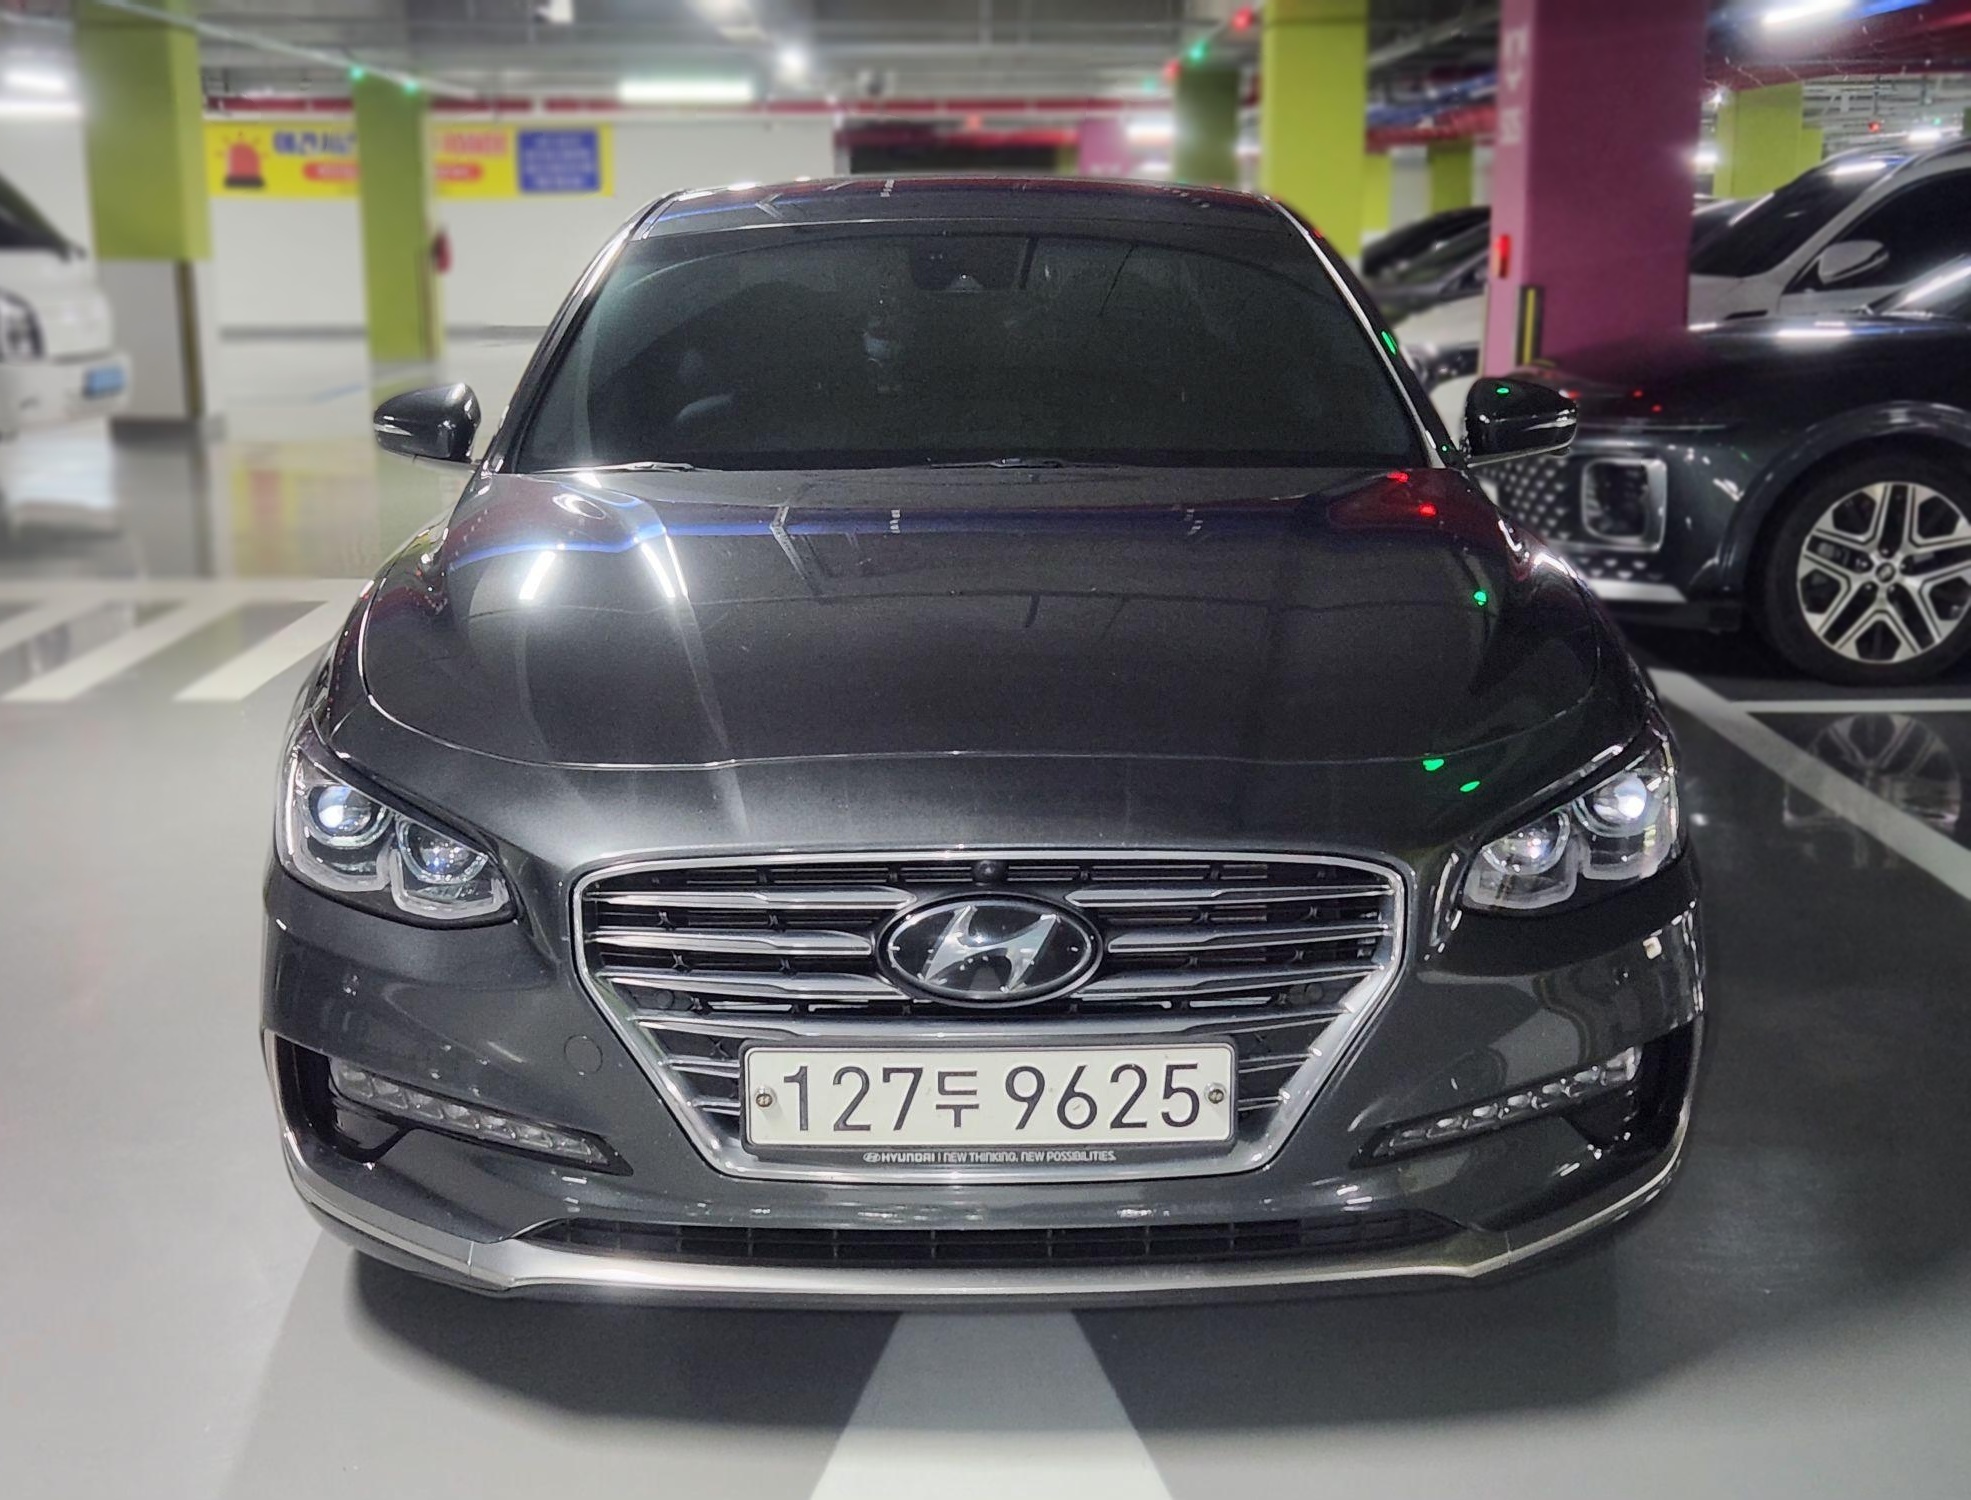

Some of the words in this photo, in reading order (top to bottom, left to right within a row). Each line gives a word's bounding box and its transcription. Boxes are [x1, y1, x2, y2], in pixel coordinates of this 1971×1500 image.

[783, 1065, 980, 1132] 127두
[1005, 1063, 1200, 1131] 9625
[881, 1152, 935, 1163] HYUNDAI
[943, 1152, 967, 1163] NEW
[1021, 1151, 1045, 1162] NEW
